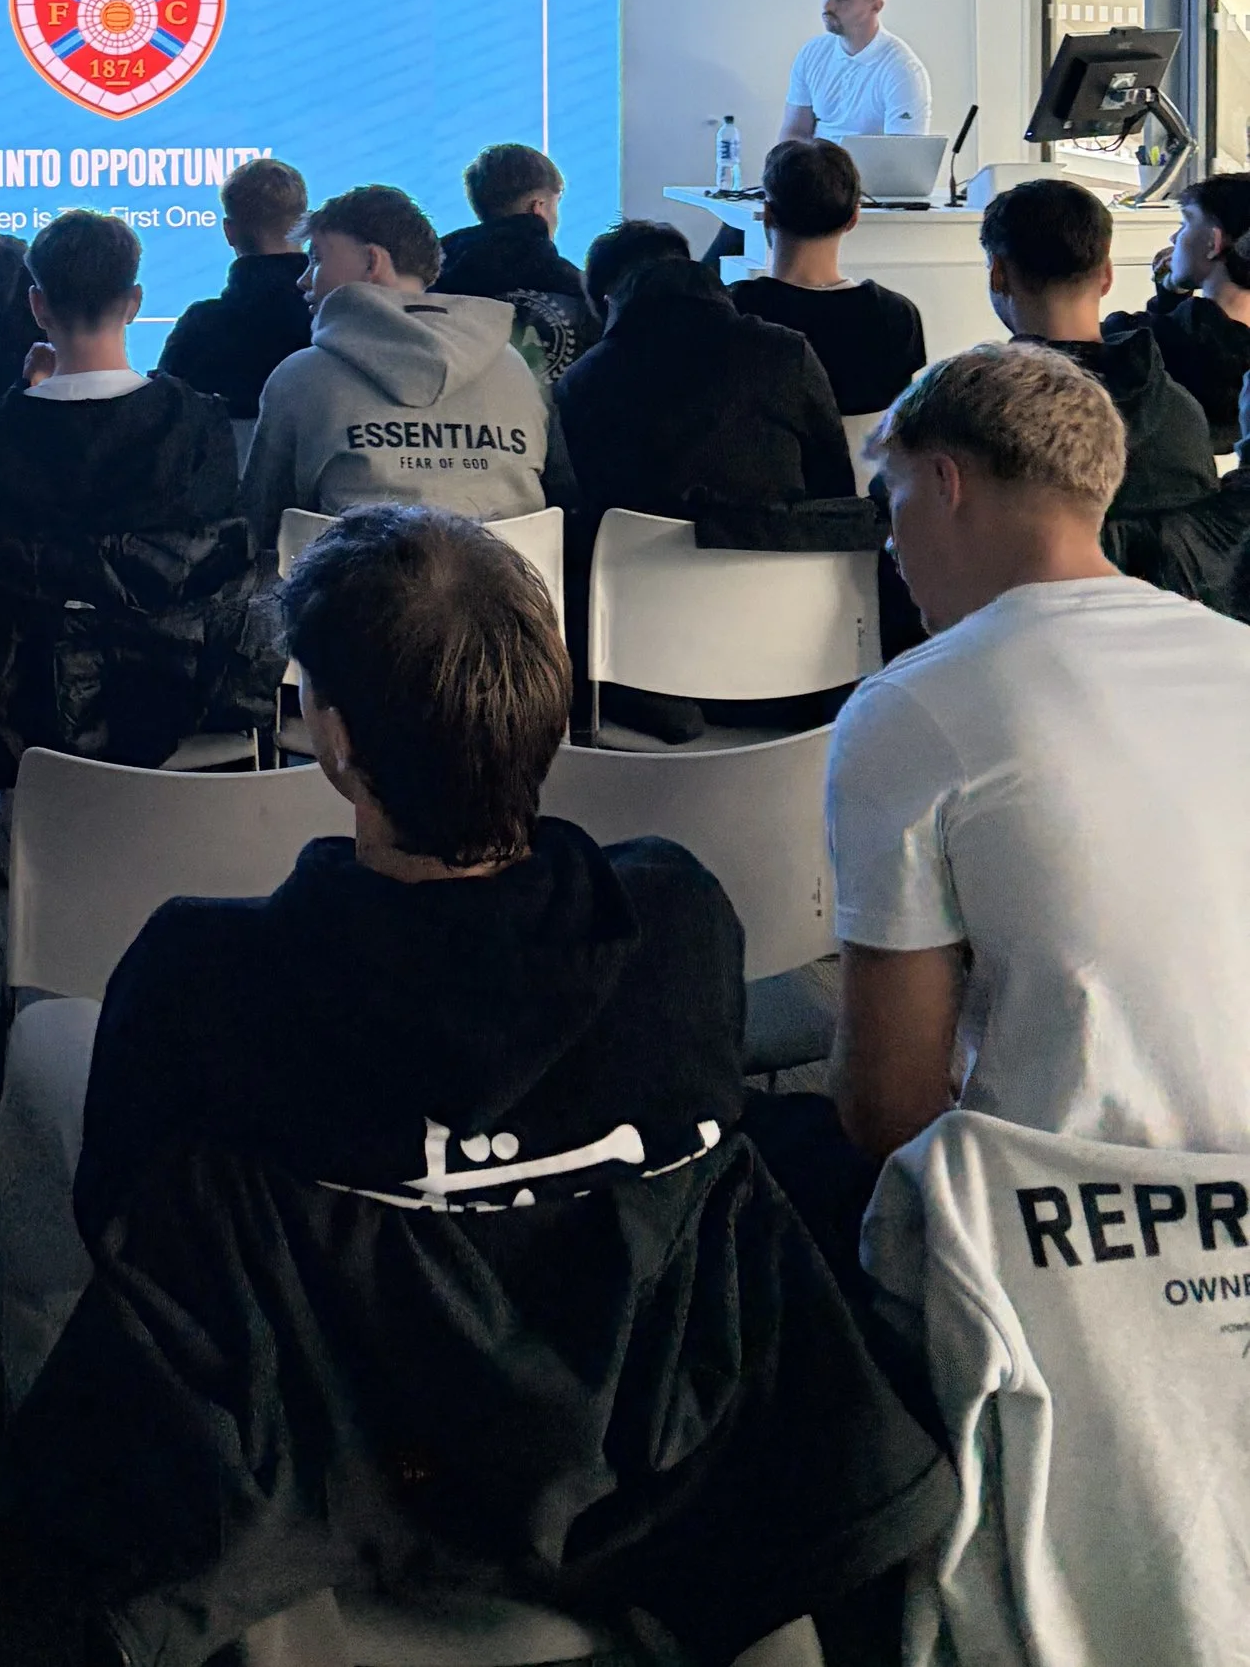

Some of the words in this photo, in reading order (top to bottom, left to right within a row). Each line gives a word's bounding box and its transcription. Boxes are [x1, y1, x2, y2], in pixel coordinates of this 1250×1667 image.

[48, 2, 69, 25] F
[165, 1, 188, 24] C
[90, 59, 146, 78] 1874
[165, 205, 216, 227] One
[347, 421, 526, 455] ESSENTIALS
[399, 456, 433, 470] FEAR
[439, 458, 454, 470] OF
[462, 458, 489, 471] GOD
[1015, 1181, 1249, 1268] REPR
